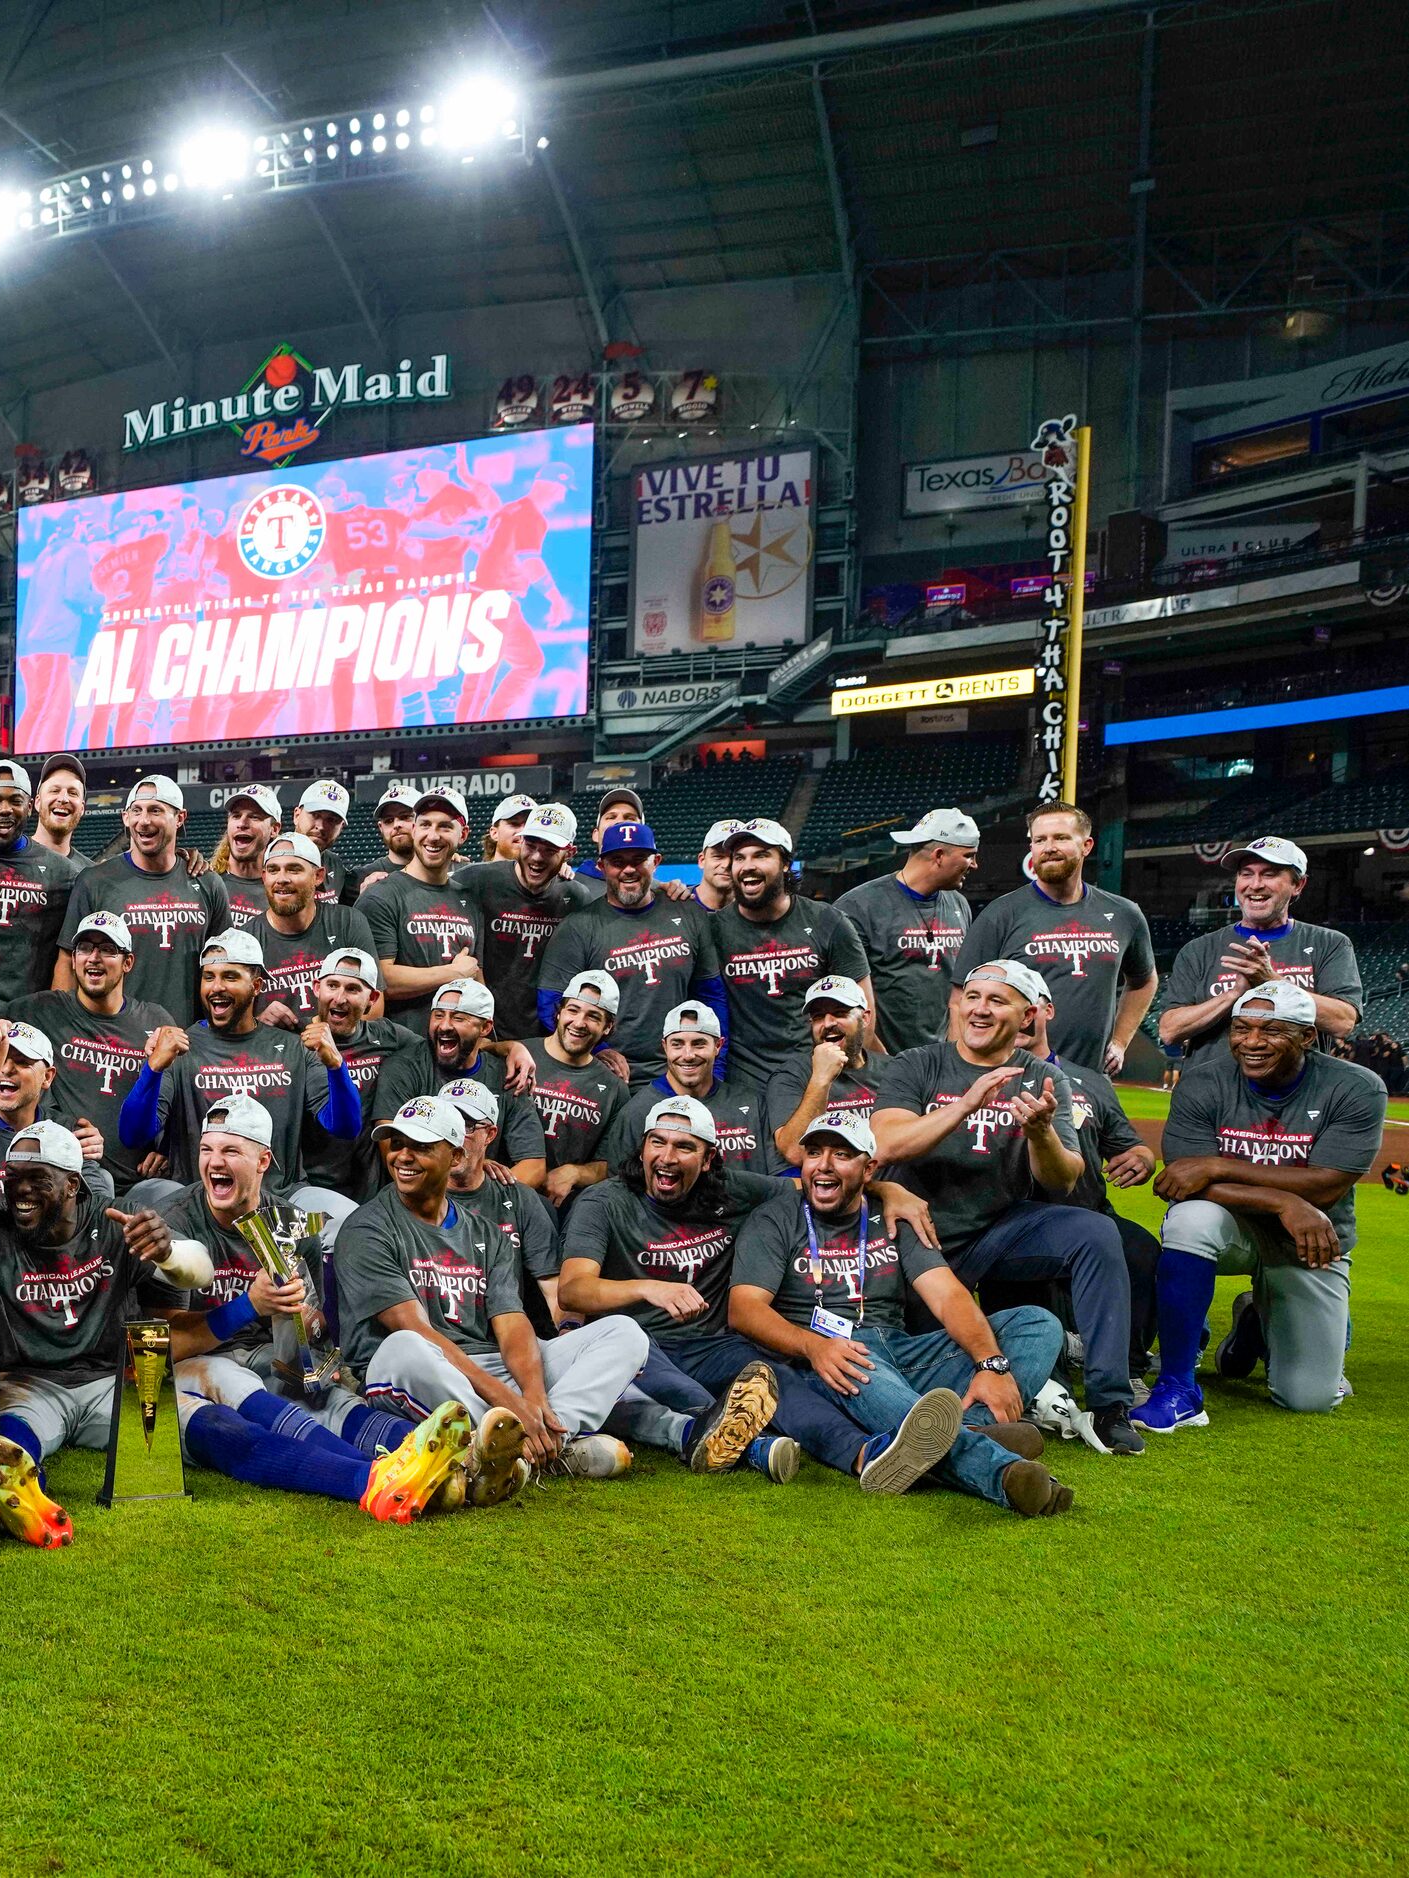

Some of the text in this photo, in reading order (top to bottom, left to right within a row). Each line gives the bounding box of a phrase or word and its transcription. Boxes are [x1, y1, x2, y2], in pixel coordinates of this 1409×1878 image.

[498, 374, 535, 404] 49
[552, 372, 593, 403] 24
[622, 371, 640, 401] 5
[683, 369, 704, 401] 7
[123, 354, 449, 449] Minute Maid
[614, 402, 649, 415] BAGWELL
[241, 418, 319, 462] Park
[734, 455, 781, 486] TU
[914, 456, 1047, 493] Texas Ba
[251, 489, 314, 518] TEXAS
[637, 478, 812, 526] ESTRELLA!
[267, 514, 296, 549] T
[346, 519, 389, 549] 53
[242, 533, 321, 574] RANGERS
[1180, 543, 1227, 558] ULTRA
[262, 593, 282, 605] TO
[290, 588, 321, 601] THE
[331, 580, 385, 597] TEXAS
[395, 570, 478, 592] RANGERS
[74, 588, 513, 708] AL CHAMPIONS
[1038, 480, 1073, 803] ROOT 4 THA CHIK
[642, 686, 722, 705] NABORS
[841, 676, 1020, 708] DOGGETT RENTS
[619, 825, 638, 842] T
[12, 881, 43, 890] LEAGUE
[121, 909, 206, 927] CHAMPIONS
[128, 902, 200, 911] AMERICAN LEAGUE
[412, 913, 446, 921] AMERICAN
[502, 911, 539, 922] AMERICAN
[407, 920, 474, 939] CHAMPIONS
[938, 928, 962, 936] LEAGUE
[1033, 931, 1113, 941] AMERICAN LEAGUE
[604, 942, 690, 972] CHAMPIONS
[611, 936, 682, 955] AMERICAN LEAGUE
[731, 947, 811, 963] AMERICAN LEAGUE
[1024, 938, 1120, 956] CHAMPIONS
[725, 953, 819, 977] CHAMPIONS
[73, 1037, 117, 1053] AMERICAN
[202, 1063, 284, 1073] AMERICAN LEAGUE
[352, 1056, 381, 1067] LEAGUE
[194, 1070, 292, 1090] CHAMPIONS
[566, 1094, 598, 1108] LEAGUE
[826, 1099, 868, 1110] AMERICAN
[716, 1126, 747, 1136] LEAGUE
[967, 1119, 995, 1151] T
[637, 1234, 734, 1268] CHAMPIONS
[649, 1228, 724, 1250] AMERICAN LEAGUE
[70, 1255, 104, 1279] LEAGUE
[15, 1259, 114, 1302] CHAMPIONS
[50, 1295, 81, 1328] T
[438, 1287, 464, 1324] T
[142, 1349, 158, 1418] AMERICAN
